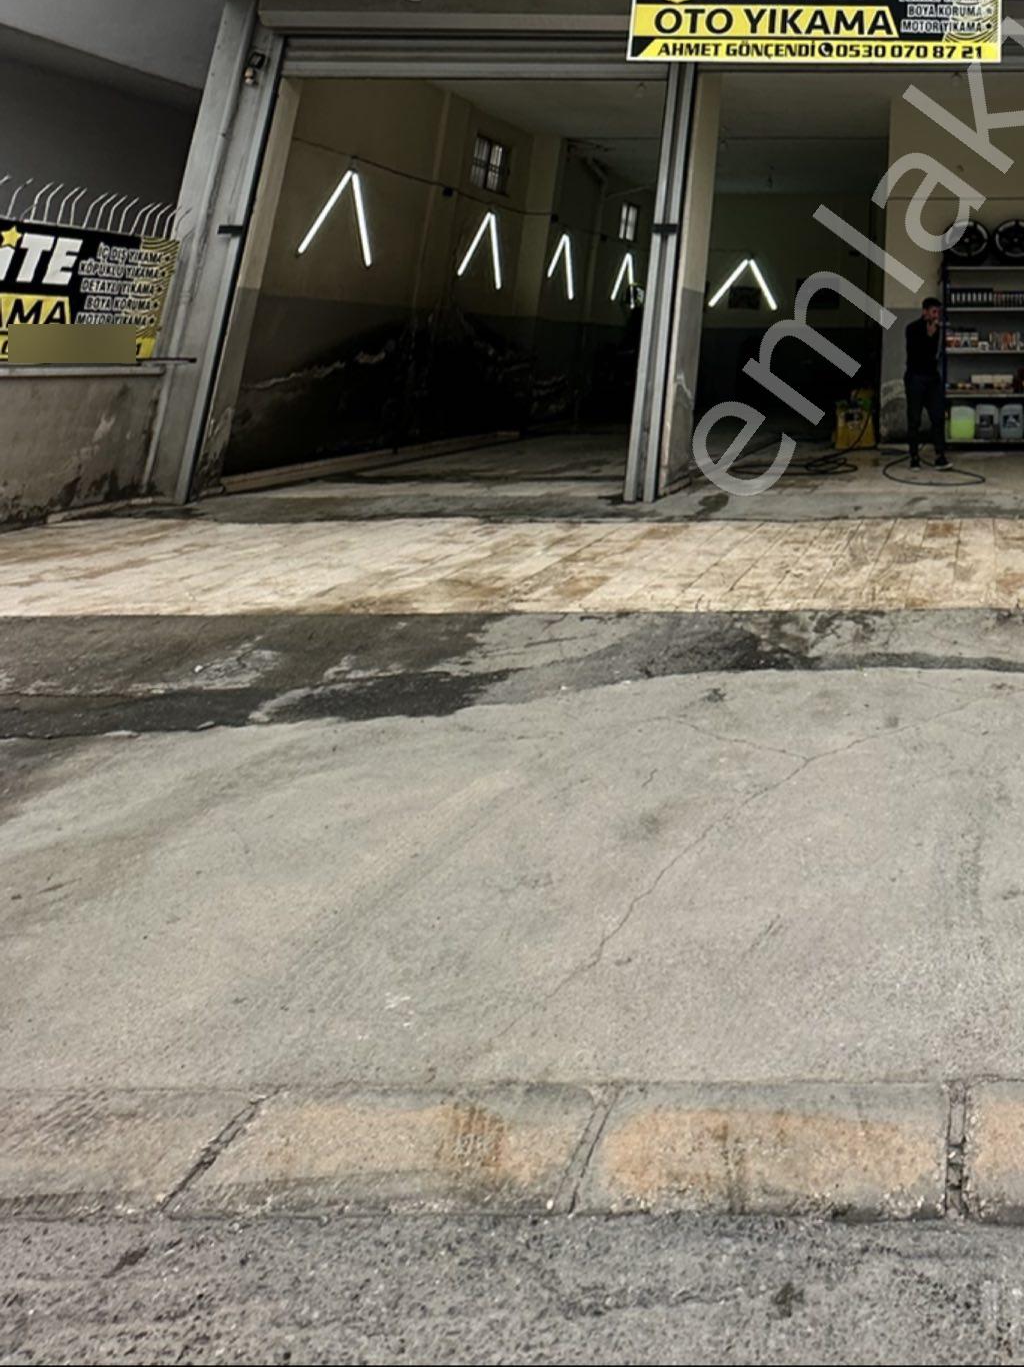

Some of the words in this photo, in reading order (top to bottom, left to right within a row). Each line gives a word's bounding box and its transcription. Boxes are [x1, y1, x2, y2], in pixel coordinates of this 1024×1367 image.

[907, 4, 936, 17] BOYA
[937, 5, 981, 18] KORUMA
[654, 8, 733, 34] OTO
[744, 9, 894, 35] YIKAMA
[901, 19, 941, 33] MOTOR
[942, 20, 981, 33] YIKAMA
[657, 42, 722, 57] AHMET
[725, 39, 816, 59] GÖNÇENDİ
[835, 45, 887, 58] 0530
[890, 45, 928, 58] 070
[932, 45, 957, 59] 87
[961, 46, 983, 59] 21
